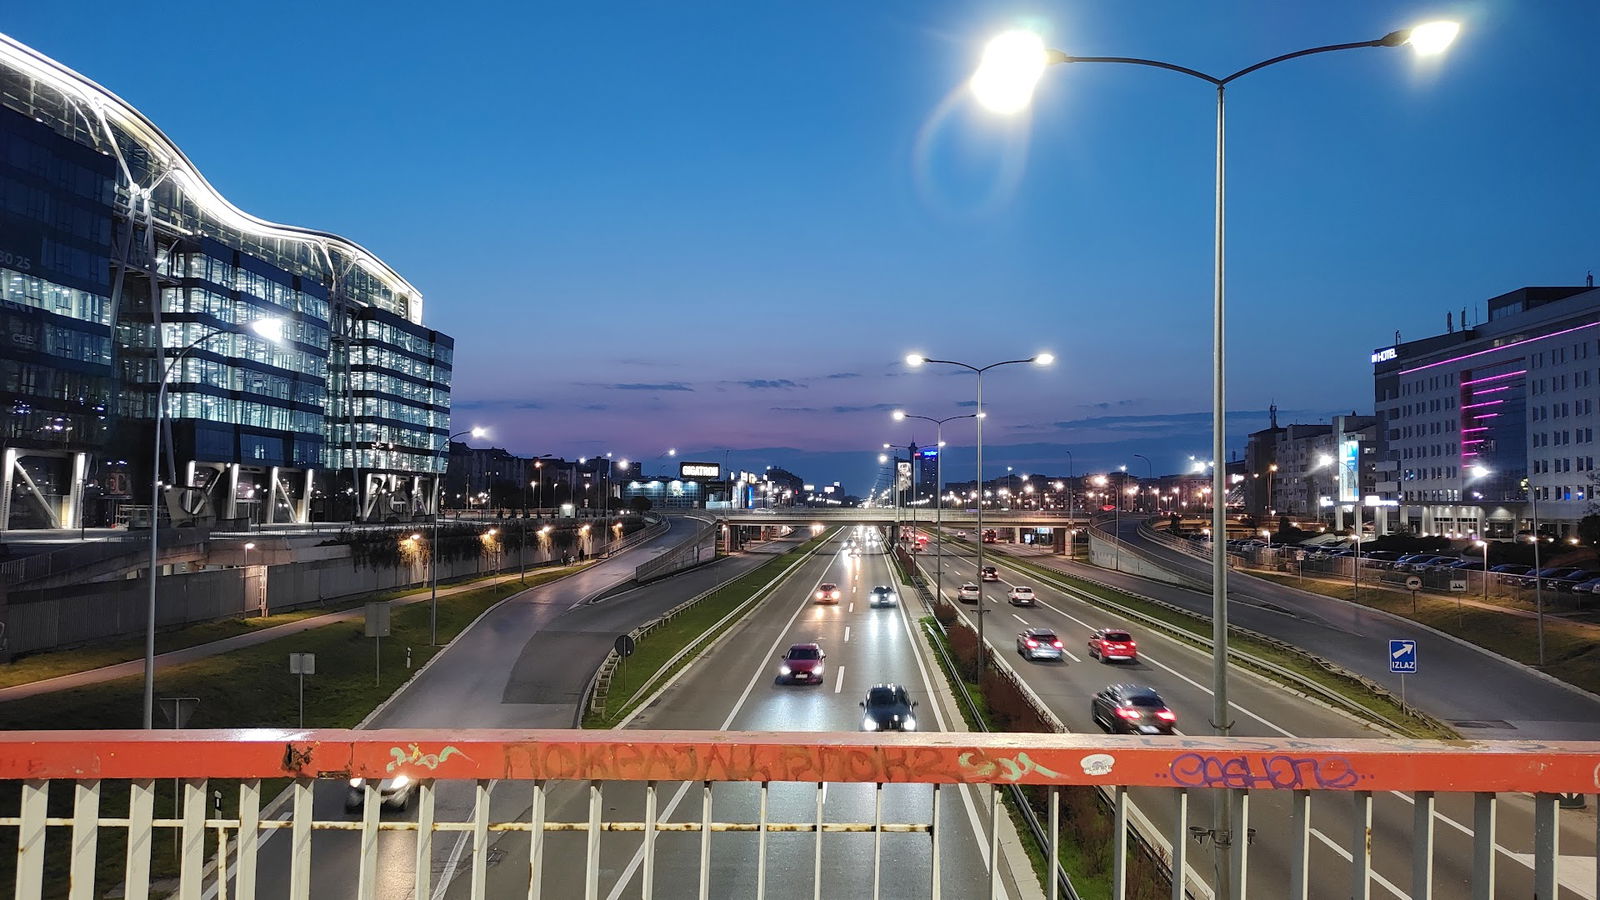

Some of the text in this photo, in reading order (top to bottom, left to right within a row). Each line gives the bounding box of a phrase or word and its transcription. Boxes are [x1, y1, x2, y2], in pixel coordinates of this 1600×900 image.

[1378, 348, 1397, 362] HOTEL
[682, 465, 719, 477] GIGATRON
[1392, 661, 1415, 669] IZLAZ
